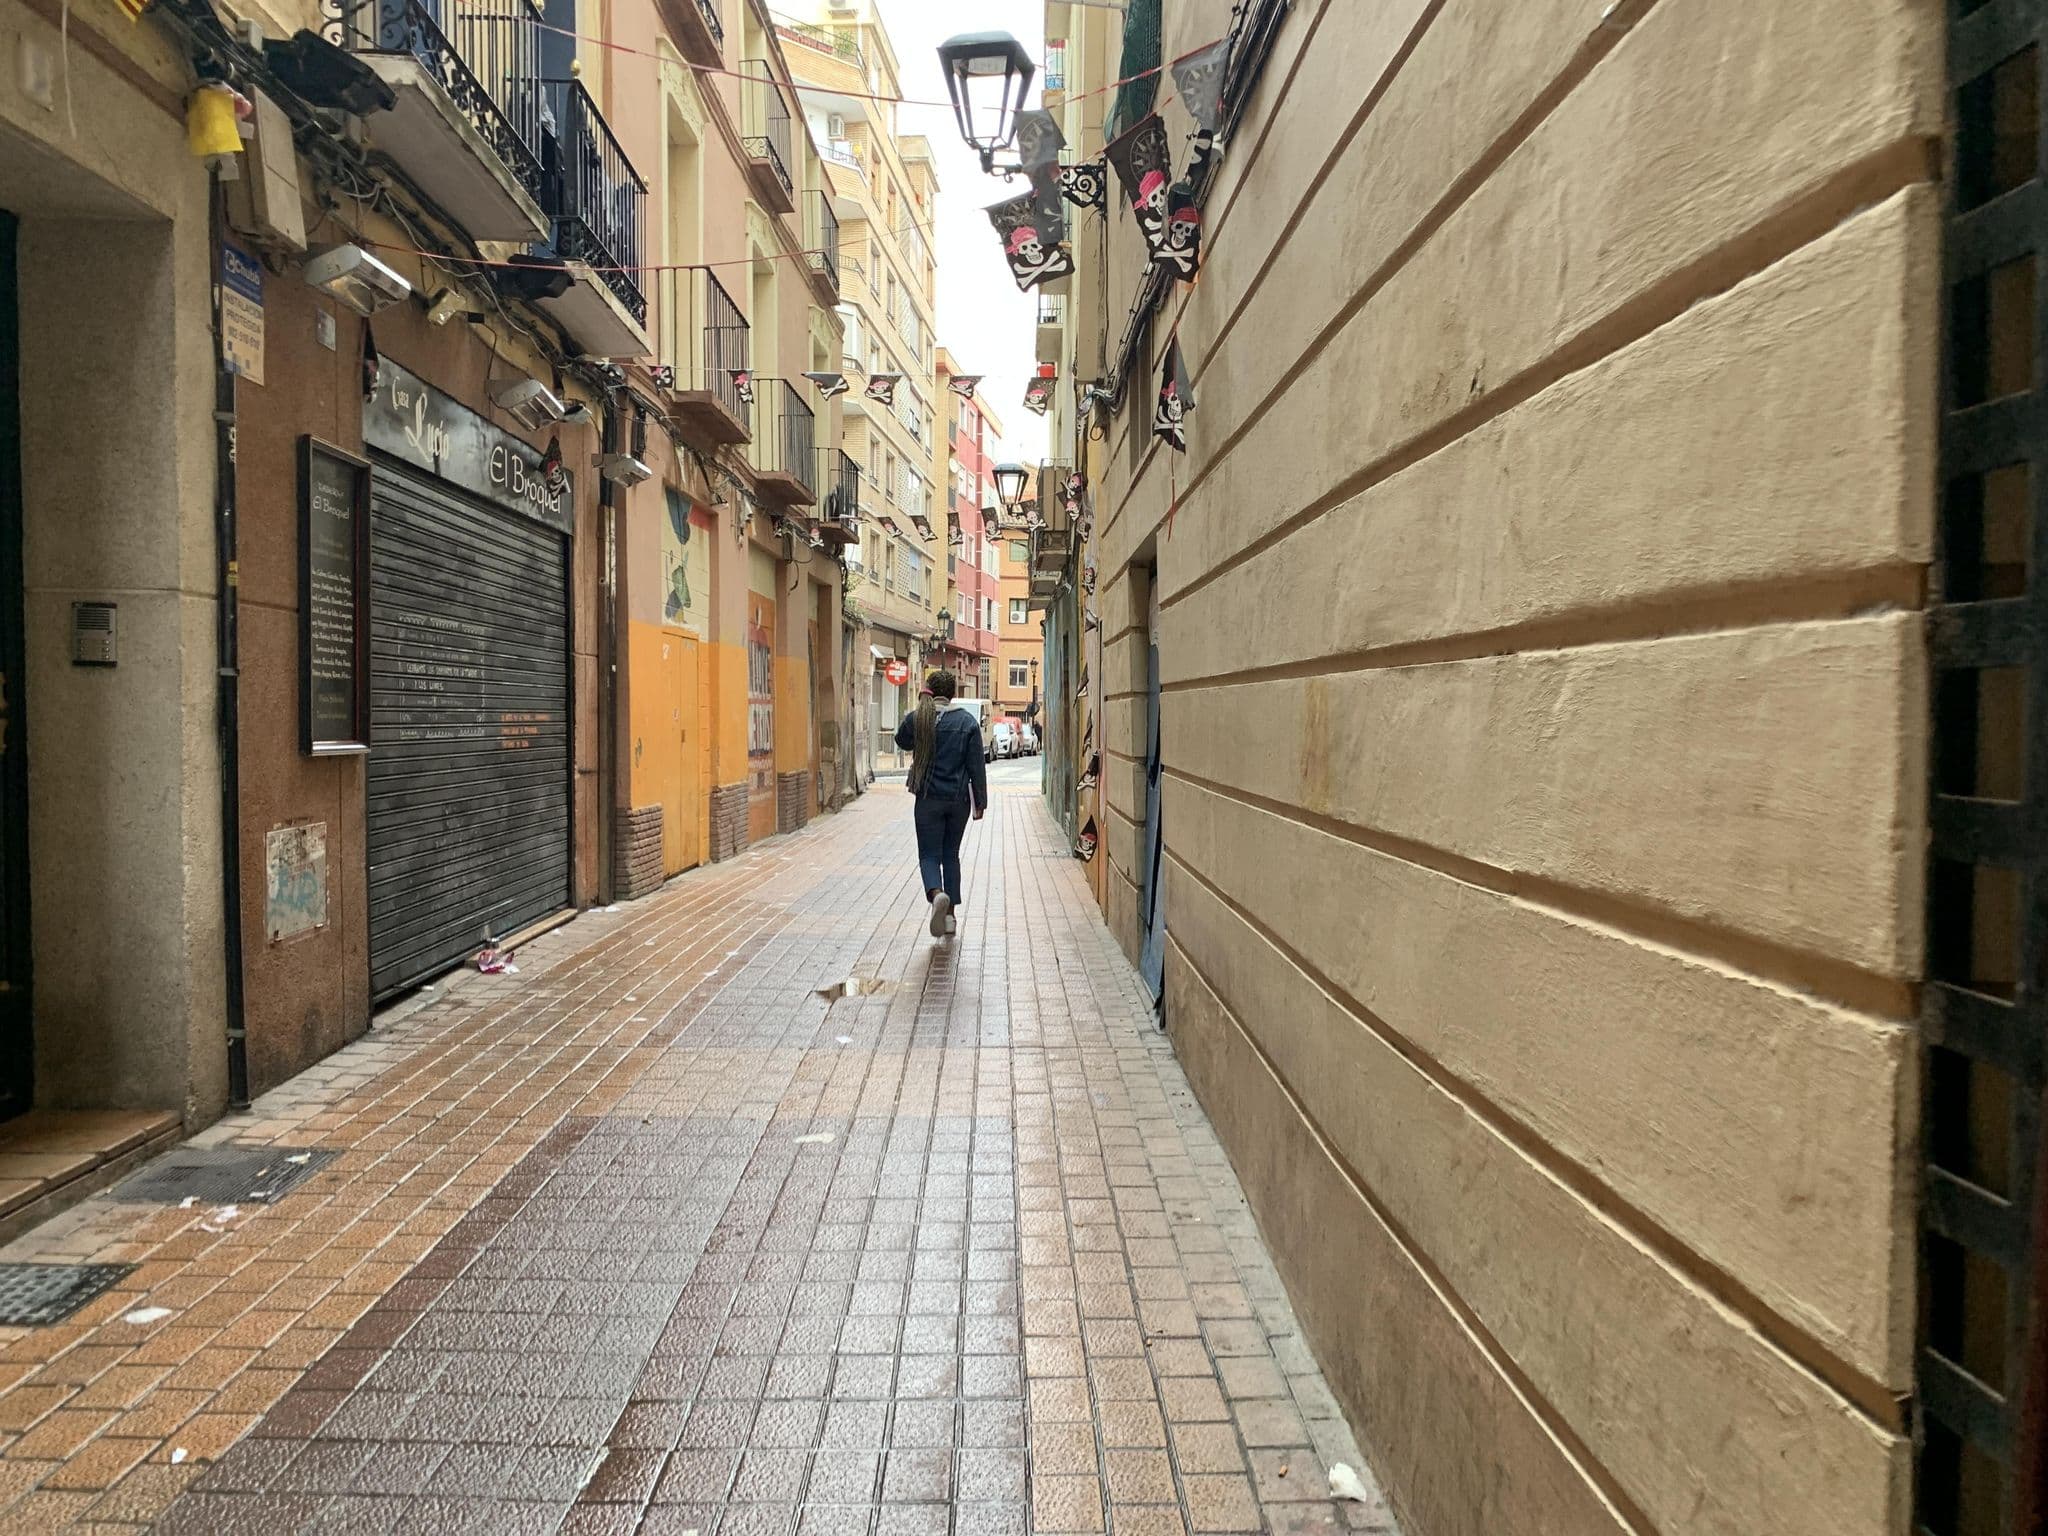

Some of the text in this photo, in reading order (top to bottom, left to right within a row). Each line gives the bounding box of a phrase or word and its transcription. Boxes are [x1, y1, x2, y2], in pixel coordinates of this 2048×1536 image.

[234, 258, 260, 286] Chubb
[391, 376, 409, 410] Casa
[404, 392, 449, 463] Lucio
[490, 446, 508, 488] El
